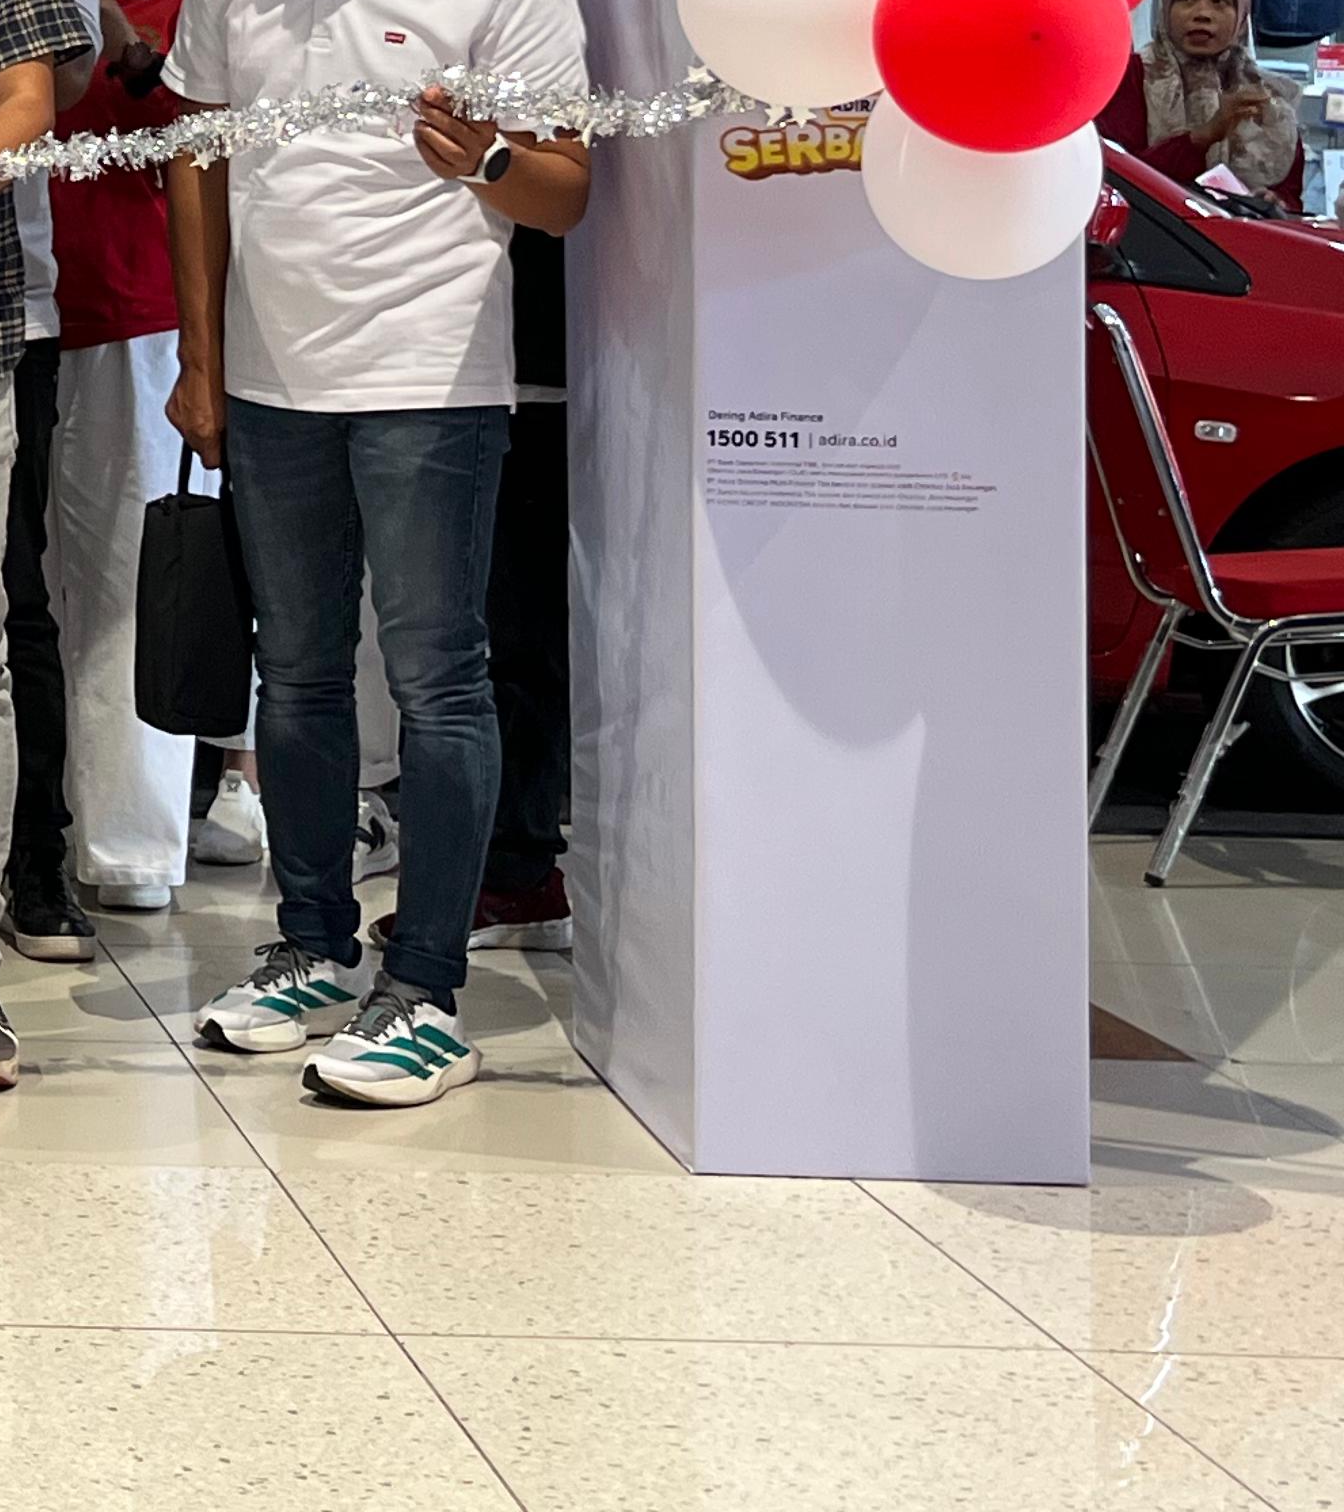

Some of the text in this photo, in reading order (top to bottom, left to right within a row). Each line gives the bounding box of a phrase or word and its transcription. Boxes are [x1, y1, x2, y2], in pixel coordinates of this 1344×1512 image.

[706, 429, 898, 448] 1500 511 adira.co.id
